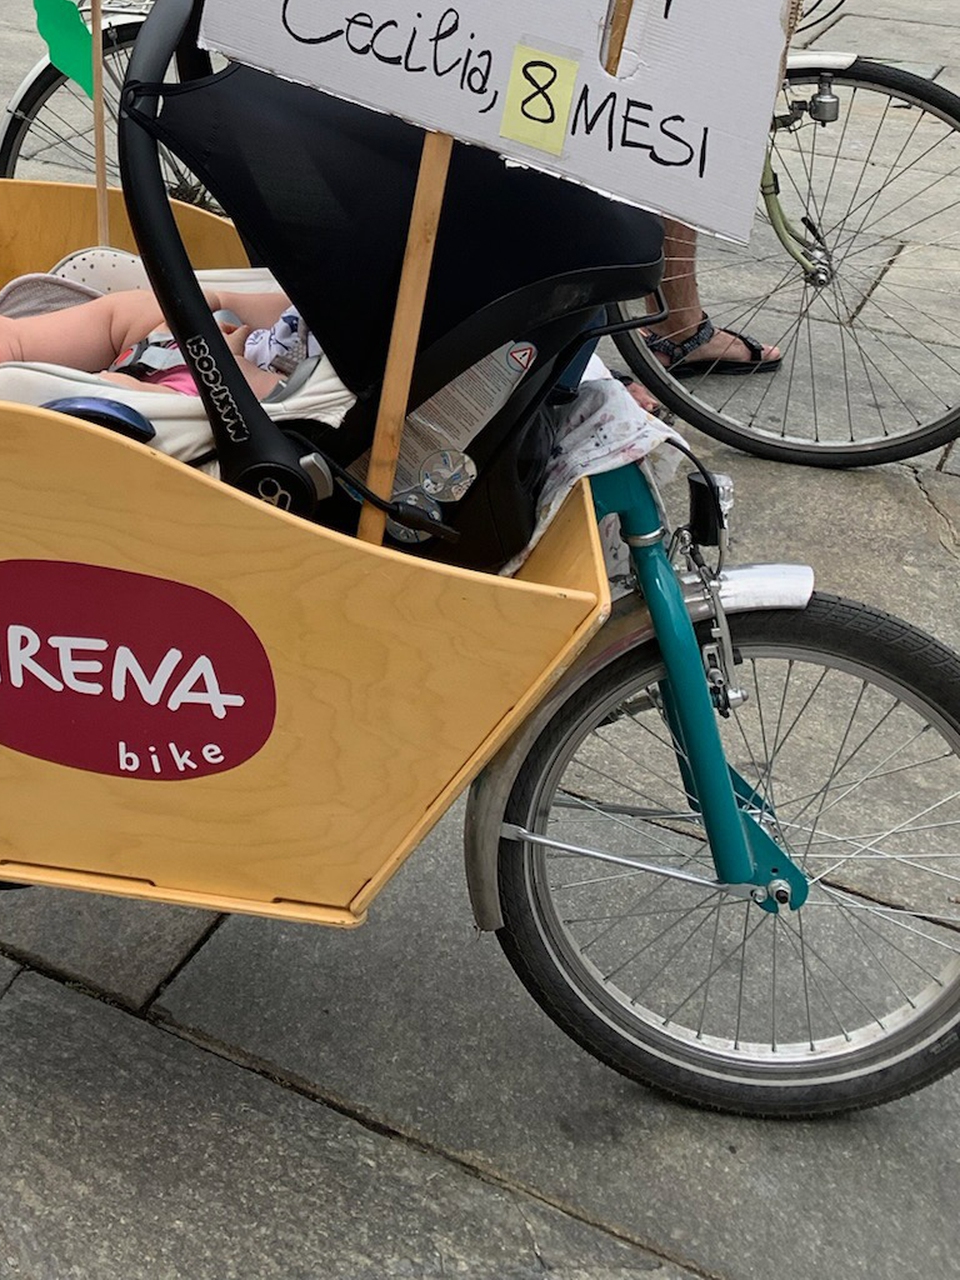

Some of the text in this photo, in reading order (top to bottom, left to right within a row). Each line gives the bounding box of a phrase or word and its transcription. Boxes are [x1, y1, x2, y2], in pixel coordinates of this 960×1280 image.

[520, 60, 558, 124] 8
[570, 83, 710, 179] MESI
[118, 741, 226, 774] bike
